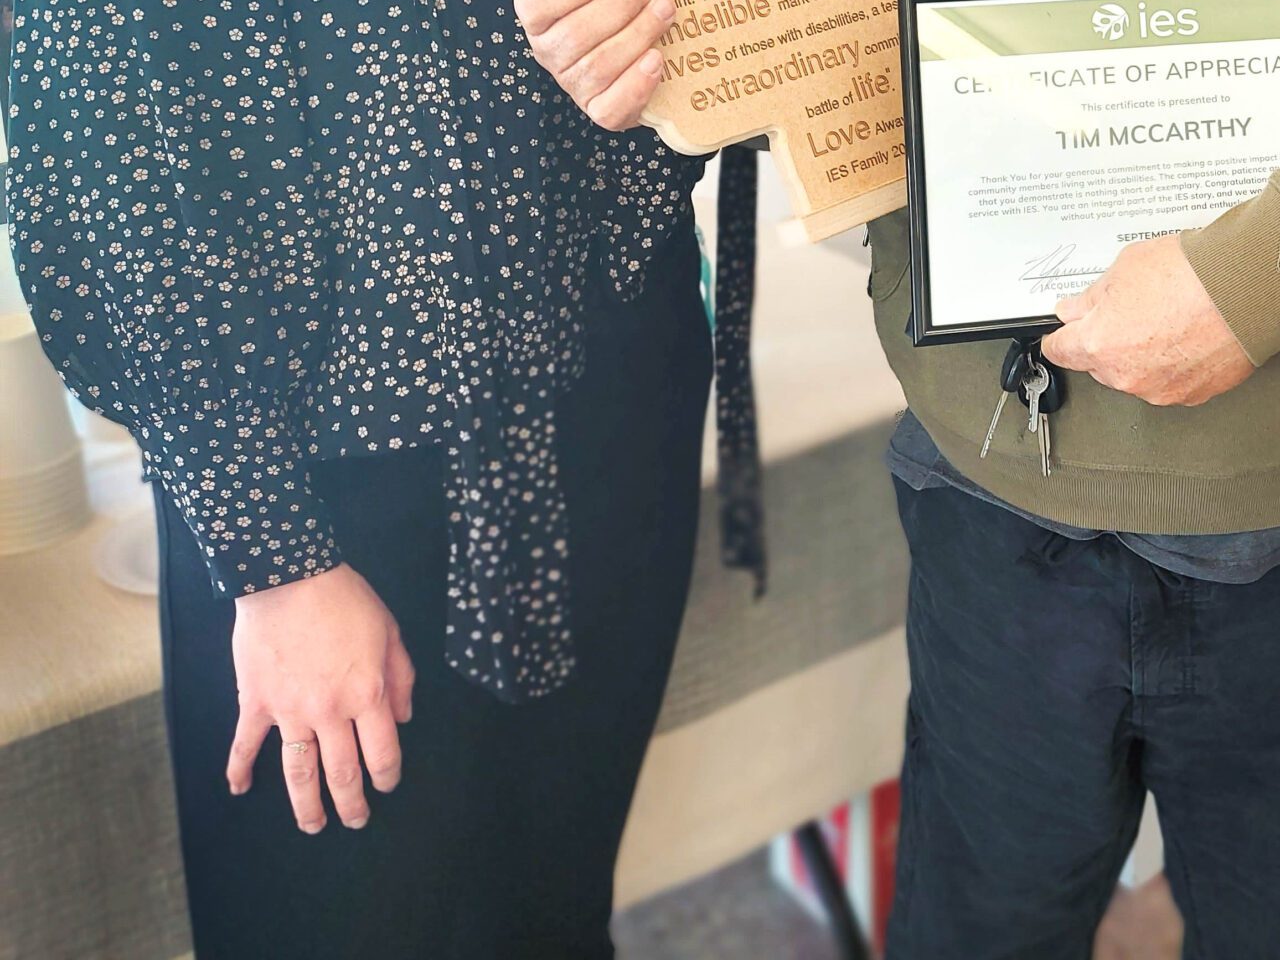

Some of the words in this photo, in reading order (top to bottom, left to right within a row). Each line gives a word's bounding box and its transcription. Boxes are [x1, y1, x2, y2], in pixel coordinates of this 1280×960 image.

[725, 46, 738, 61] of
[740, 38, 775, 56] those
[777, 28, 803, 45] with
[805, 10, 869, 36] disabilities,
[871, 6, 880, 16] a
[1138, 1, 1199, 38] ies
[690, 40, 858, 111] extraordinary
[1125, 64, 1157, 82] OF
[805, 99, 839, 118] battle
[842, 91, 854, 106] of
[1081, 102, 1102, 112] This
[1105, 99, 1155, 111] certificate
[1158, 98, 1166, 107] is
[1168, 95, 1218, 107] presented
[1221, 94, 1230, 102] to
[807, 120, 871, 157] Love
[1056, 128, 1100, 149] TIM
[1109, 117, 1251, 145] MCCARTHY
[826, 164, 849, 182] IES
[850, 151, 888, 173] Family
[968, 185, 1016, 196] community
[1019, 183, 1059, 192] members
[1062, 179, 1085, 189] living
[1087, 178, 1106, 187] with
[1159, 172, 1174, 181] The
[1177, 169, 1229, 181] compassion,
[1232, 165, 1267, 175] patience
[981, 175, 1008, 184] Thank
[1029, 172, 1041, 180] for
[1044, 172, 1062, 180] your
[1066, 168, 1105, 178] generous
[1108, 163, 1160, 174] commitment
[1174, 159, 1205, 169] making
[1215, 158, 1247, 167] positive
[1250, 154, 1277, 163] impact
[968, 209, 999, 219] service
[1002, 207, 1021, 216] with
[1042, 204, 1059, 212] You
[1092, 197, 1124, 208] integral
[1127, 198, 1145, 207] part
[1147, 195, 1156, 203] of
[1158, 194, 1172, 202] the
[1175, 193, 1188, 201] IES
[1191, 192, 1214, 201] story,
[1216, 189, 1232, 198] and
[979, 198, 997, 206] that
[1000, 197, 1015, 207] you
[1018, 191, 1073, 203] demonstrate
[1085, 187, 1117, 198] nothing
[1121, 186, 1142, 195] short
[1145, 185, 1153, 193] of
[1061, 212, 1094, 221] without
[1096, 211, 1115, 220] your
[1118, 207, 1153, 219] ongoing
[1156, 204, 1188, 214] support
[1191, 201, 1207, 210] and
